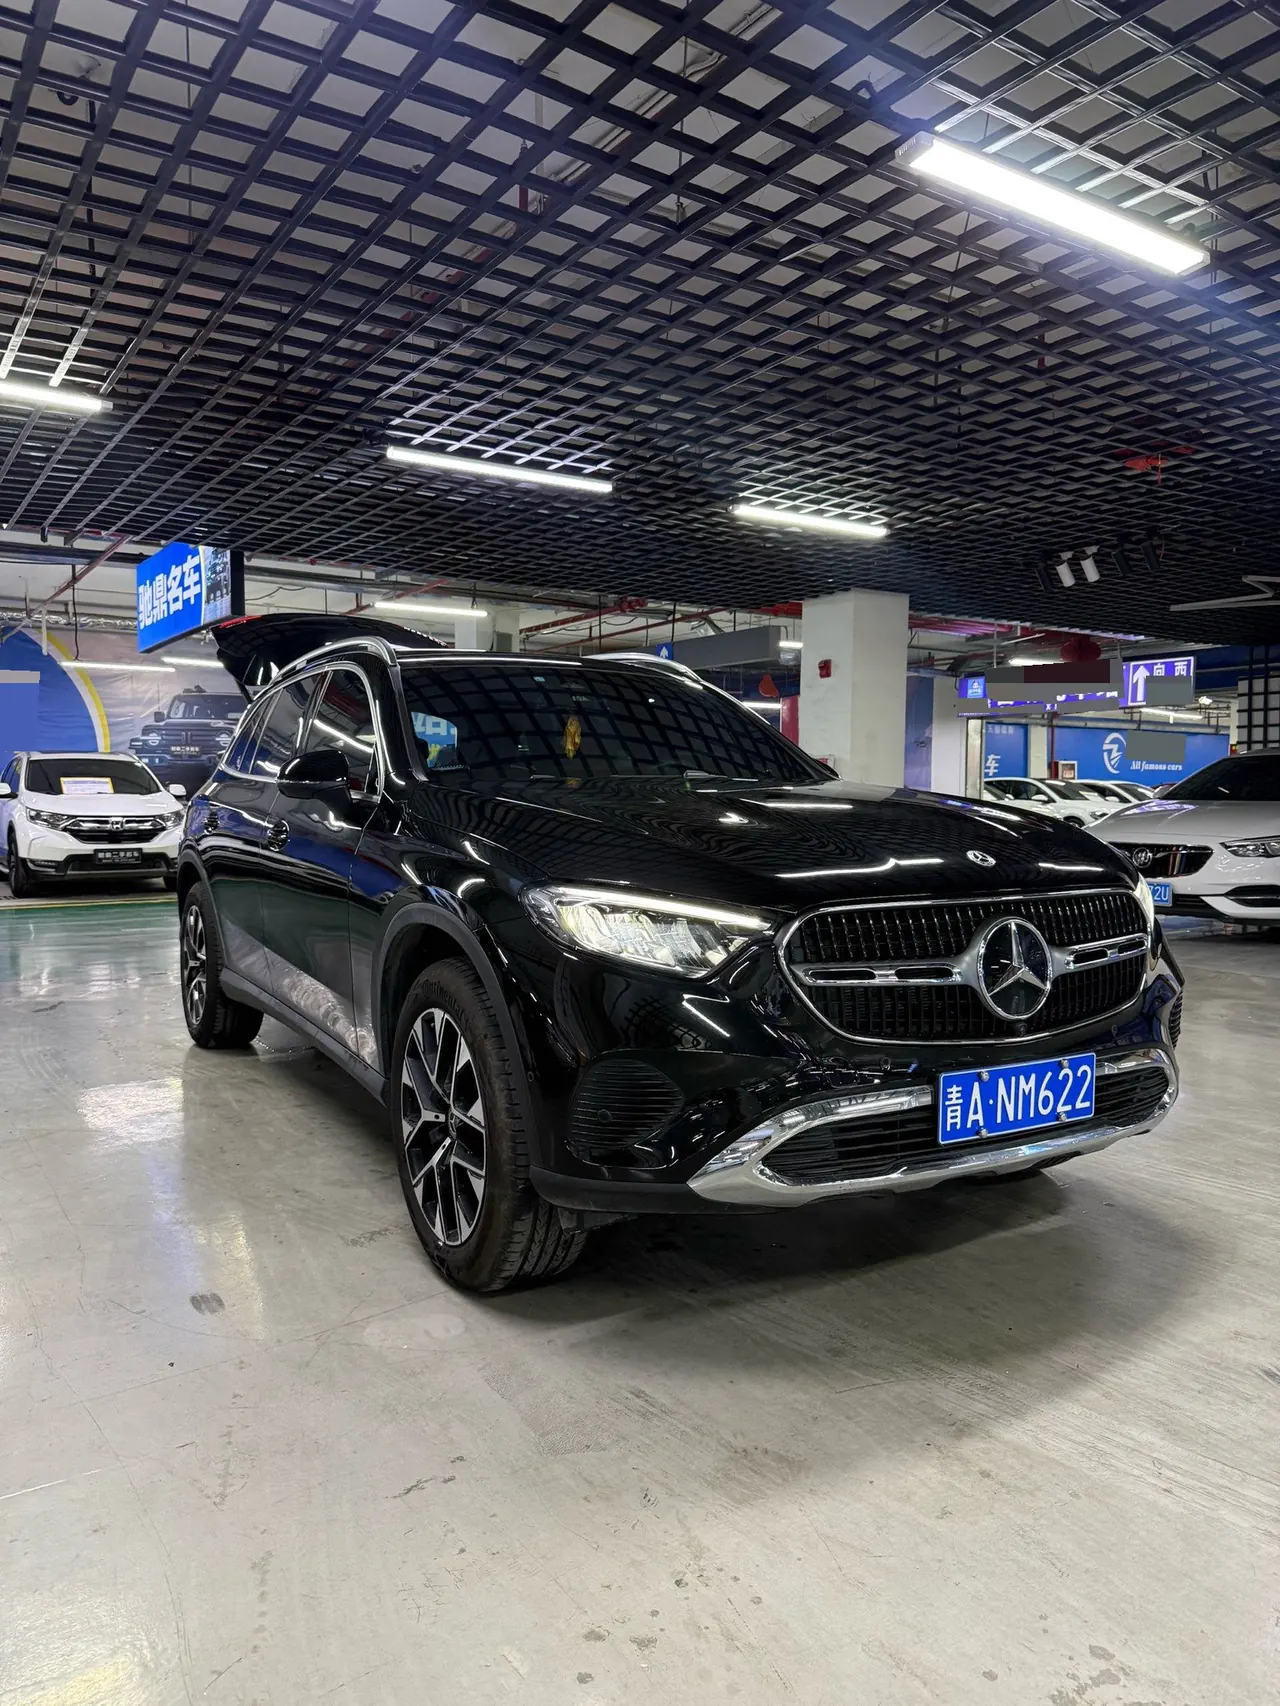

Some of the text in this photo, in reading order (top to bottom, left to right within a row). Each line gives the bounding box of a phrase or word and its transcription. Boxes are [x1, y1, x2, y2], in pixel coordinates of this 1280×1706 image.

[138, 554, 201, 630] 驰鼎名车
[984, 753, 1001, 776] 车
[1130, 760, 1140, 770] All
[1140, 761, 1166, 772] famous
[945, 1064, 1092, 1132] 青A·NM622
